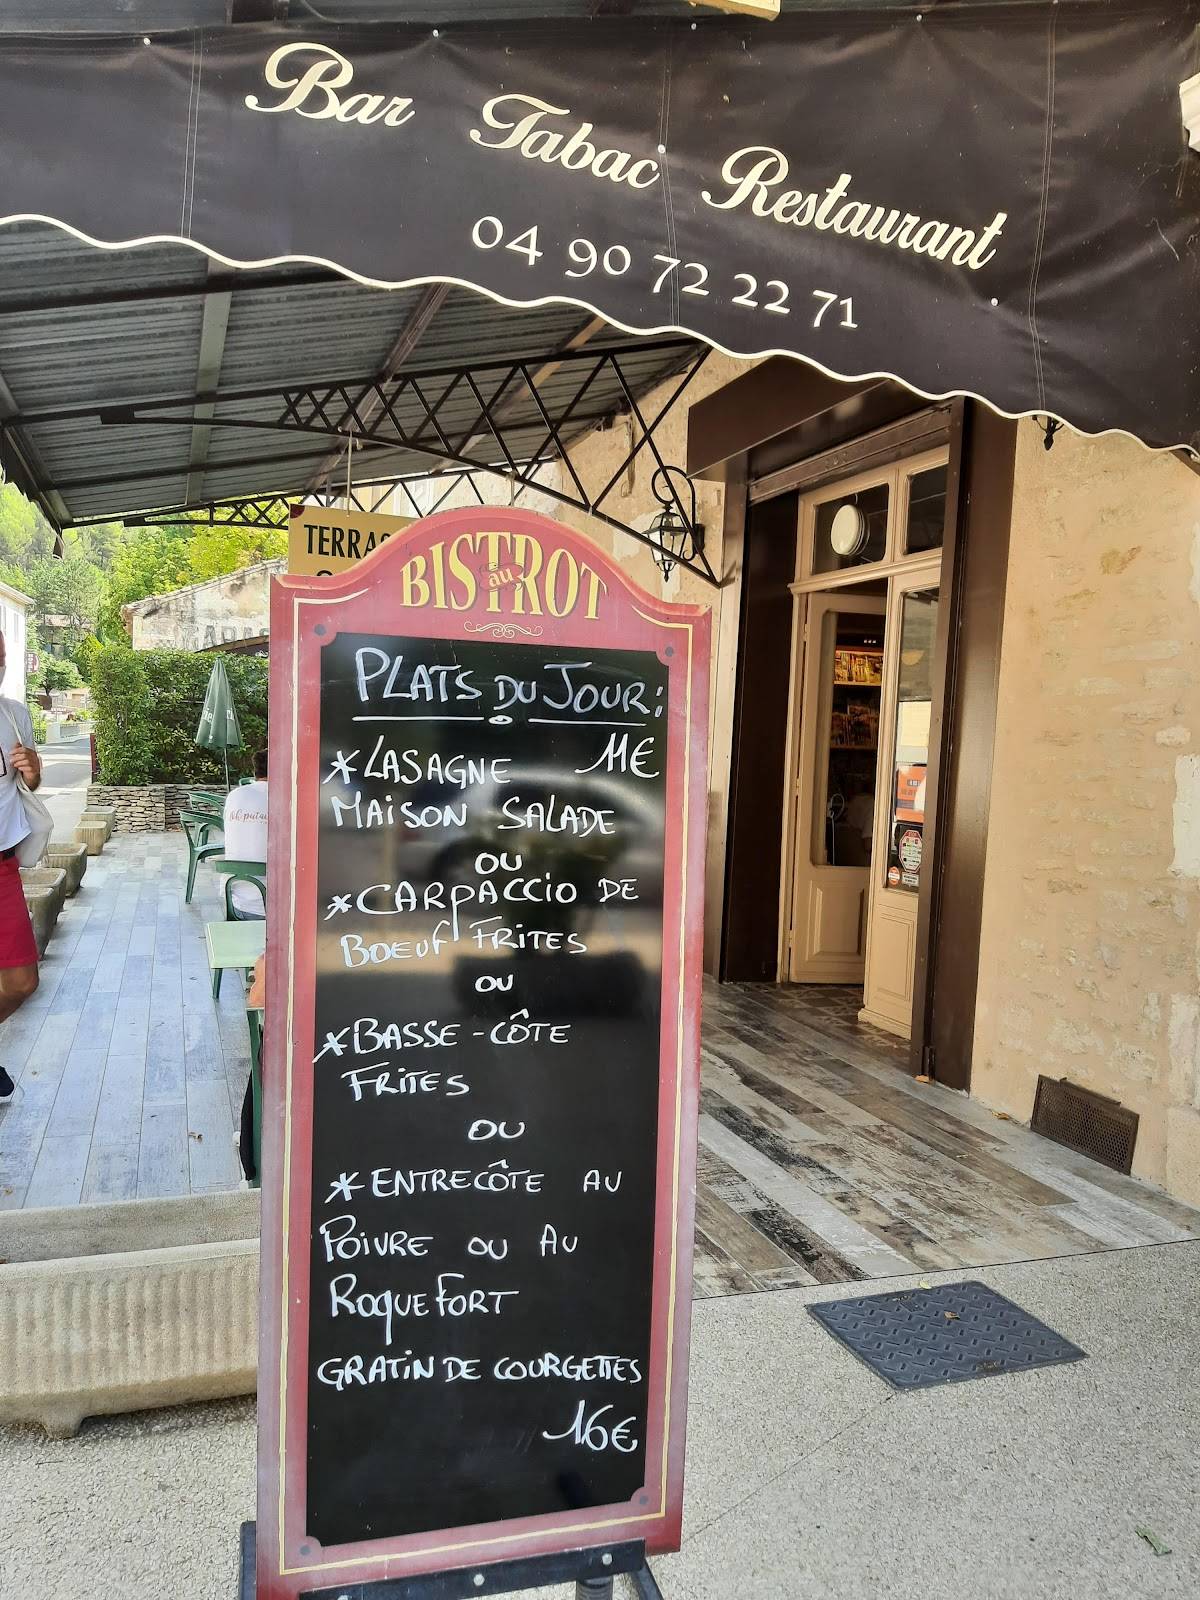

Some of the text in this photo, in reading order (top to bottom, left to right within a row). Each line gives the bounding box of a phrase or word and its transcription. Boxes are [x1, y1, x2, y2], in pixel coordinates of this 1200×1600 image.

[245, 42, 1008, 270] Bar Tabac Restaurant
[471, 215, 858, 330] 04 90 72 22 71
[399, 531, 608, 620] BISTROT
[488, 566, 514, 589] au
[354, 646, 665, 718] PLATS DU JOUR:
[497, 794, 616, 838] SALADE
[474, 852, 524, 878] OU
[598, 877, 639, 904] DE
[474, 973, 514, 993] OU
[467, 1118, 526, 1141] OU
[583, 1168, 623, 1193] AU
[442, 1356, 482, 1383] DE
[492, 1351, 643, 1385] COURGETTES
[541, 1399, 639, 1453] 16€
